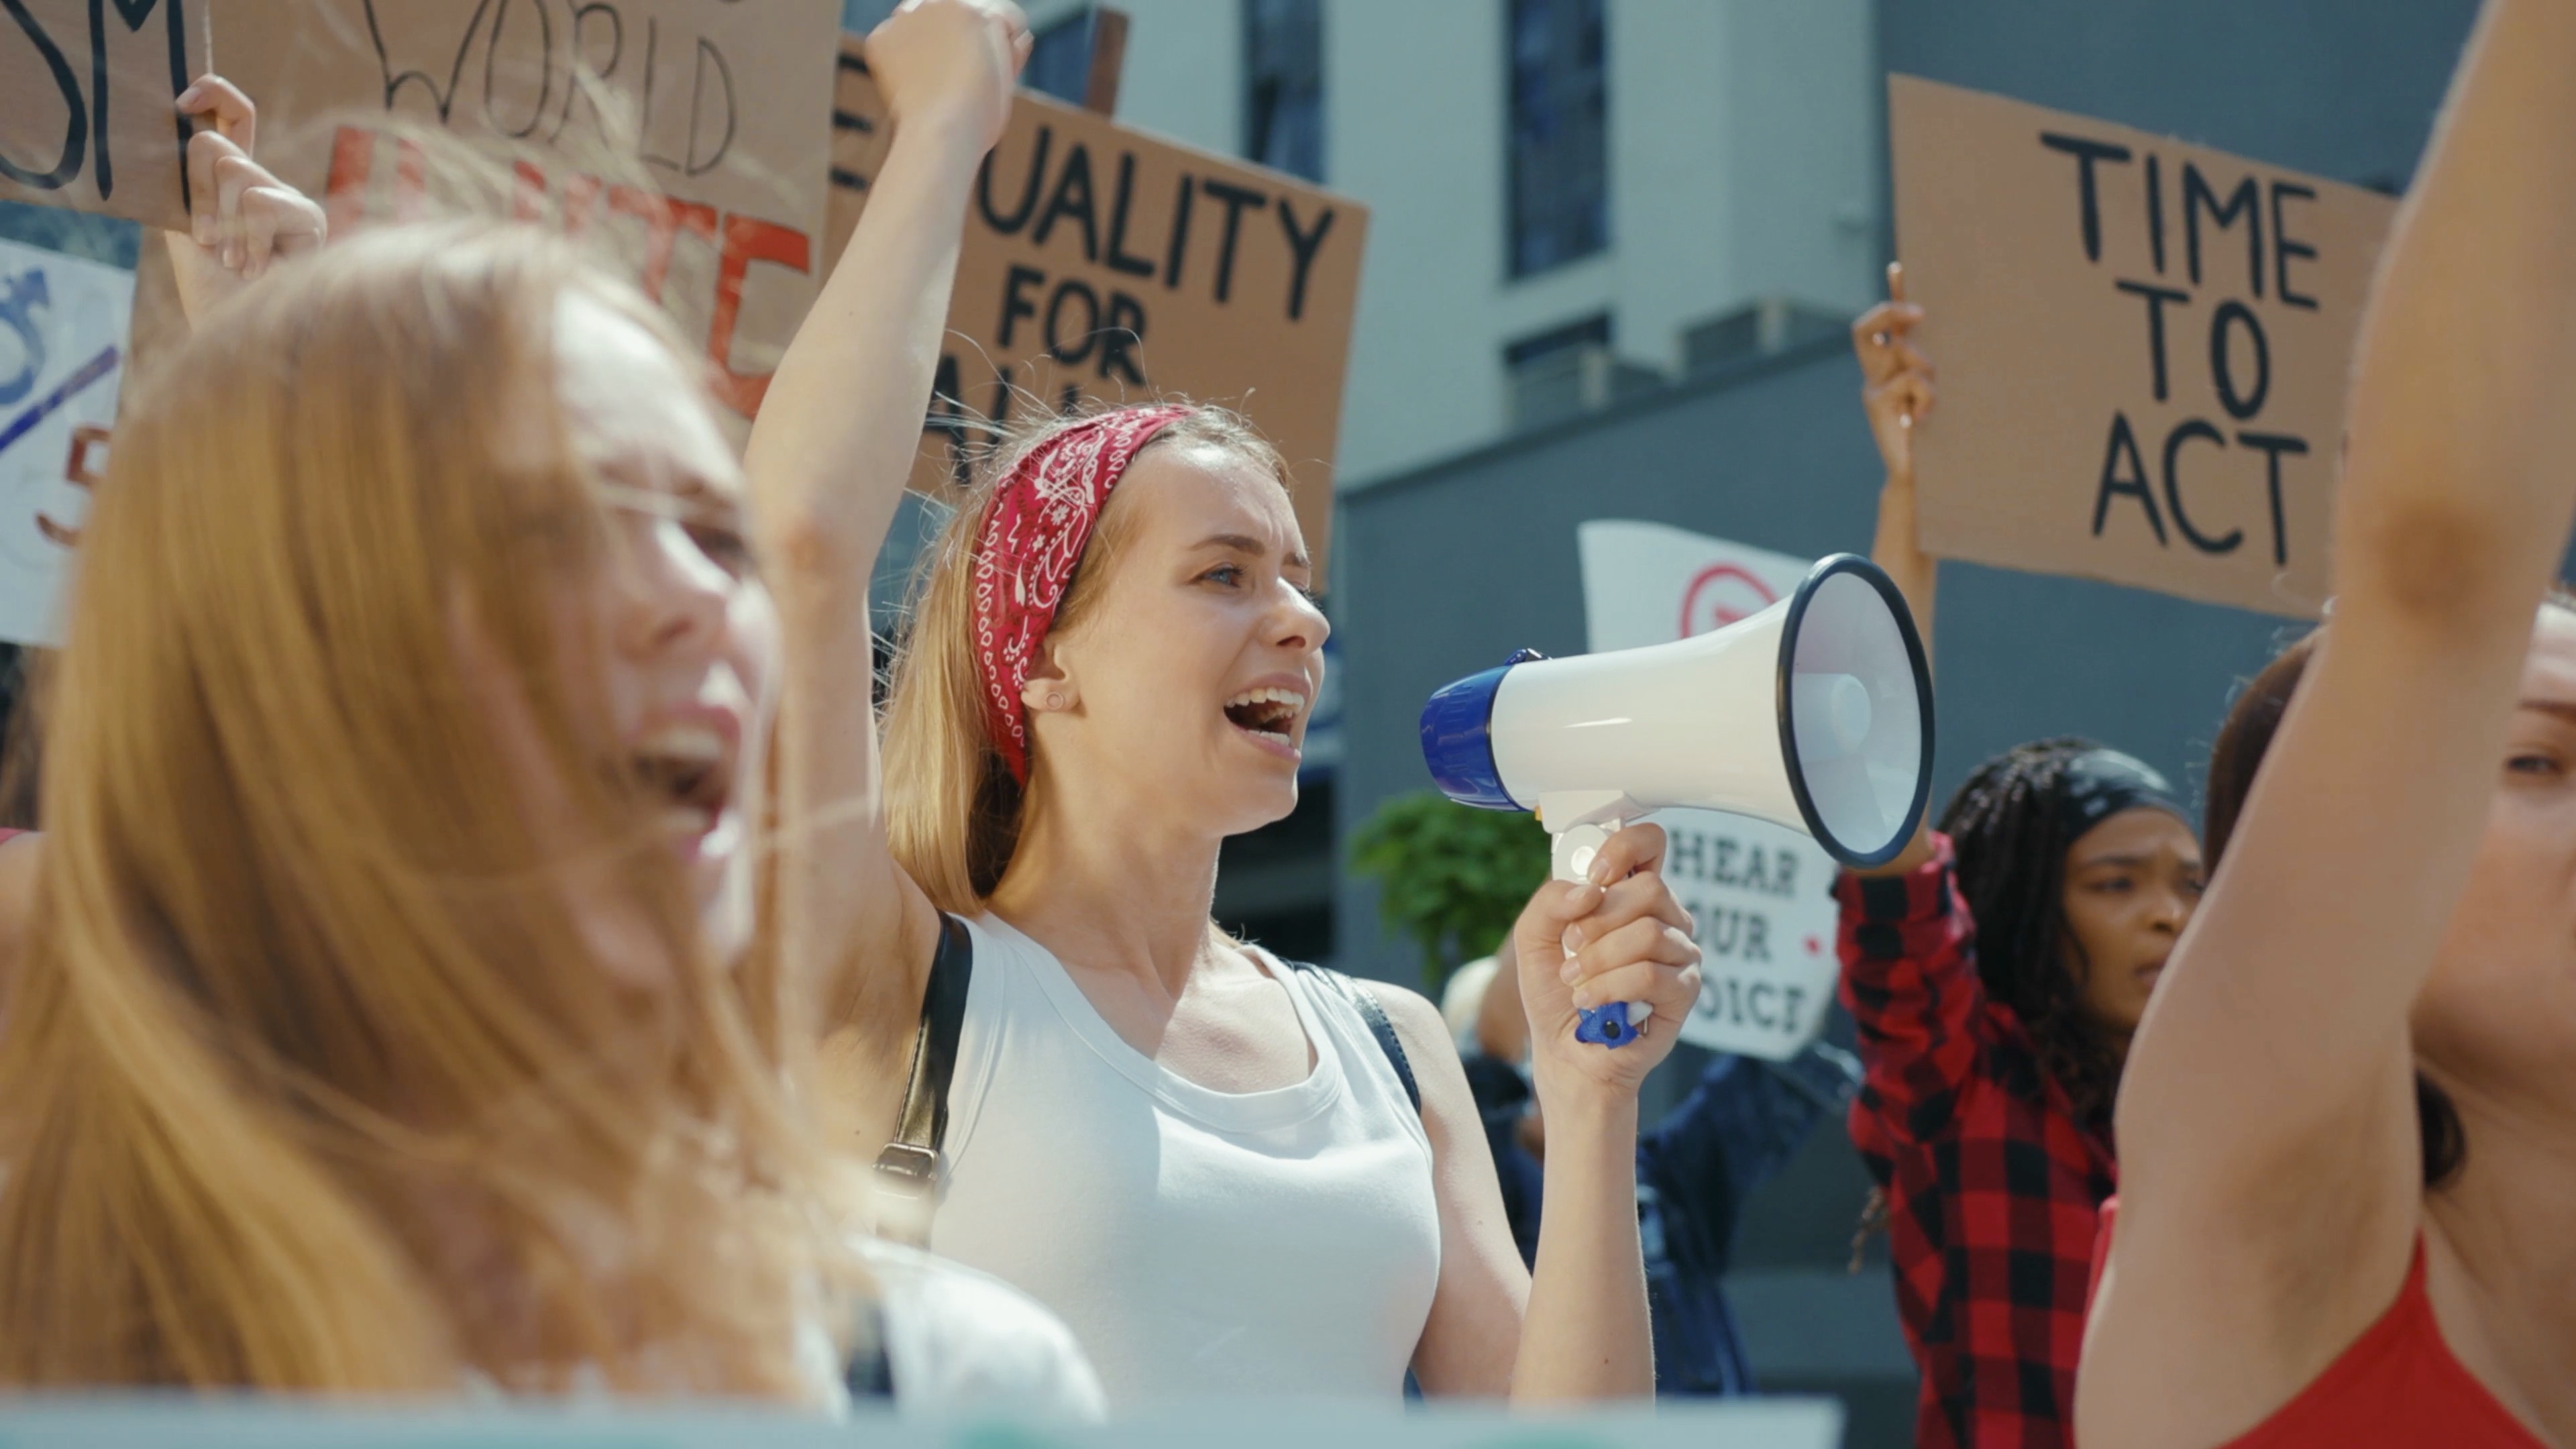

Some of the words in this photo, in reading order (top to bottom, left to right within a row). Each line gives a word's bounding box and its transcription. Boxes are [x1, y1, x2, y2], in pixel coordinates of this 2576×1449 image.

[829, 48, 1334, 321] EUALITY
[2040, 132, 2320, 311] TIME
[998, 266, 1145, 386] FOR
[2116, 280, 2270, 421] TO
[2094, 411, 2309, 568] ACT
[1669, 830, 1798, 896] HEAR
